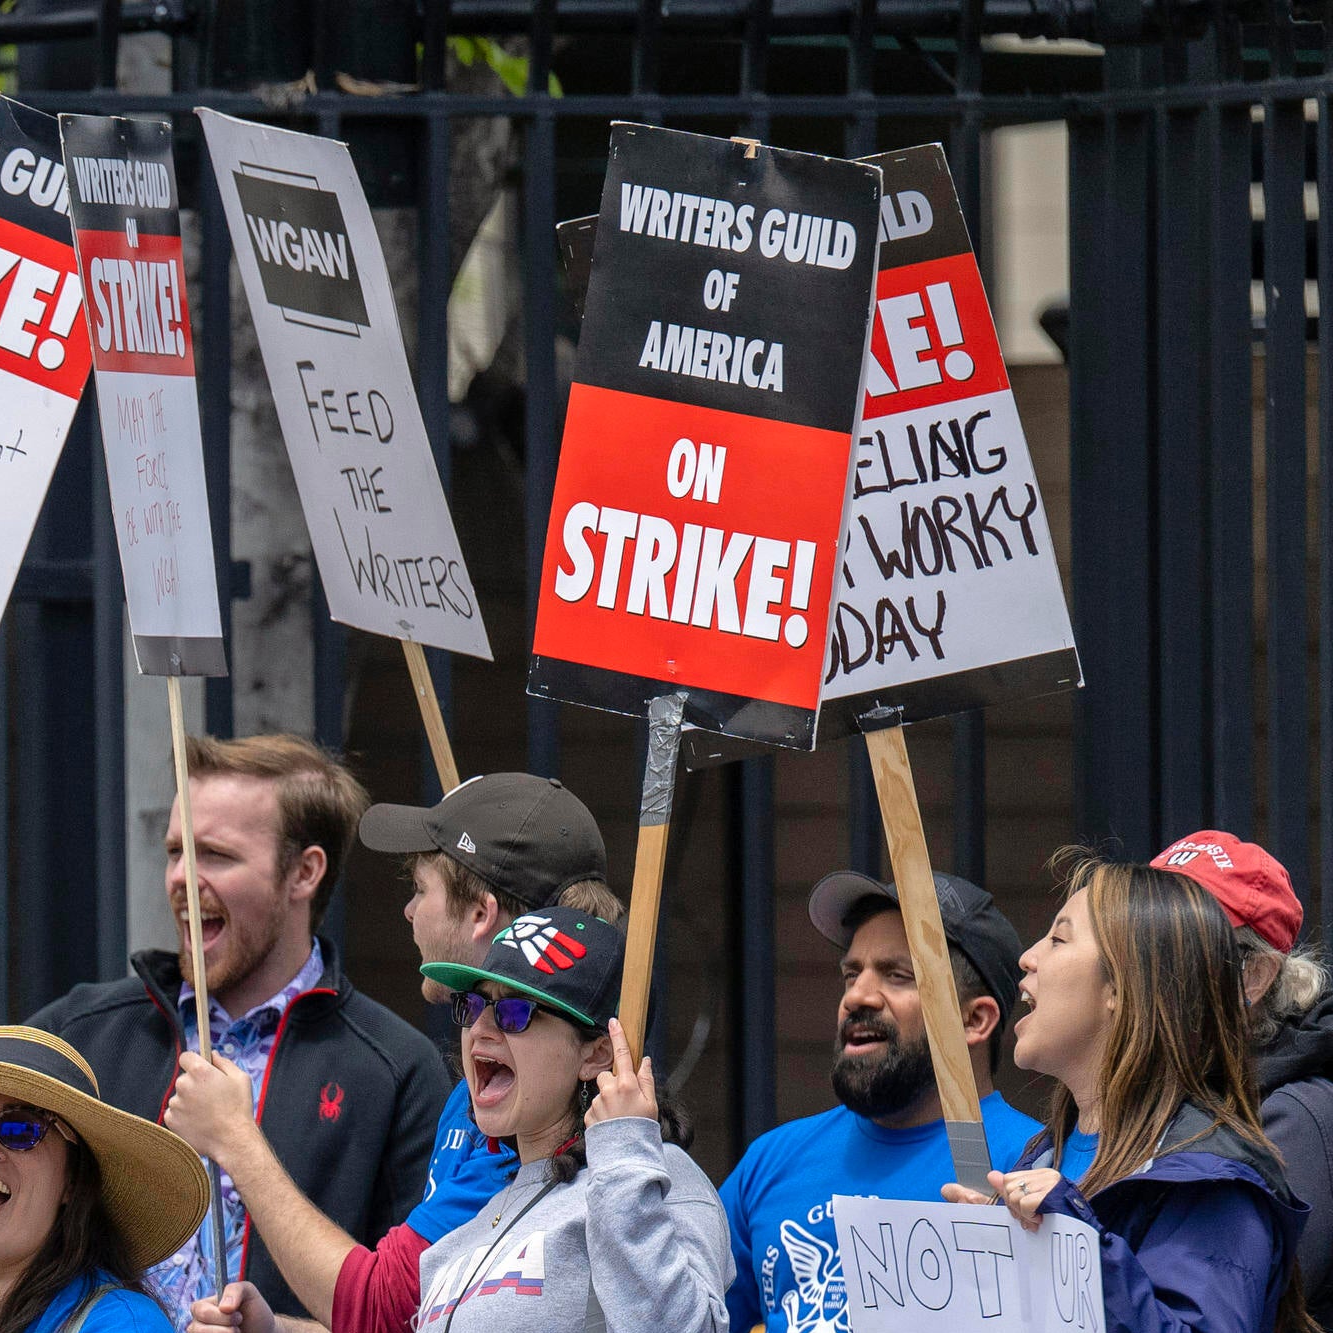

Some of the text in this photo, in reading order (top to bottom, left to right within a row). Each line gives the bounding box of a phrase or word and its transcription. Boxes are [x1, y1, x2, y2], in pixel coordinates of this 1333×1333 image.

[72, 157, 171, 209] WRITERS GUILD
[619, 181, 755, 253] WRITERS
[759, 208, 857, 271] GUILD
[126, 217, 139, 248] ON
[246, 213, 350, 281] WGAW
[91, 256, 185, 358] STRIKE!
[703, 268, 740, 312] OF
[638, 320, 785, 393] AMERICA
[295, 359, 395, 451] FEED
[340, 465, 392, 515] THE
[666, 438, 727, 504] ON
[853, 409, 1007, 499] ELING
[333, 506, 474, 621] WRITERS
[554, 501, 818, 649] STRIKE!
[858, 483, 1039, 581] WORKY
[833, 590, 946, 674] DAY
[850, 1218, 1014, 1319] NOT
